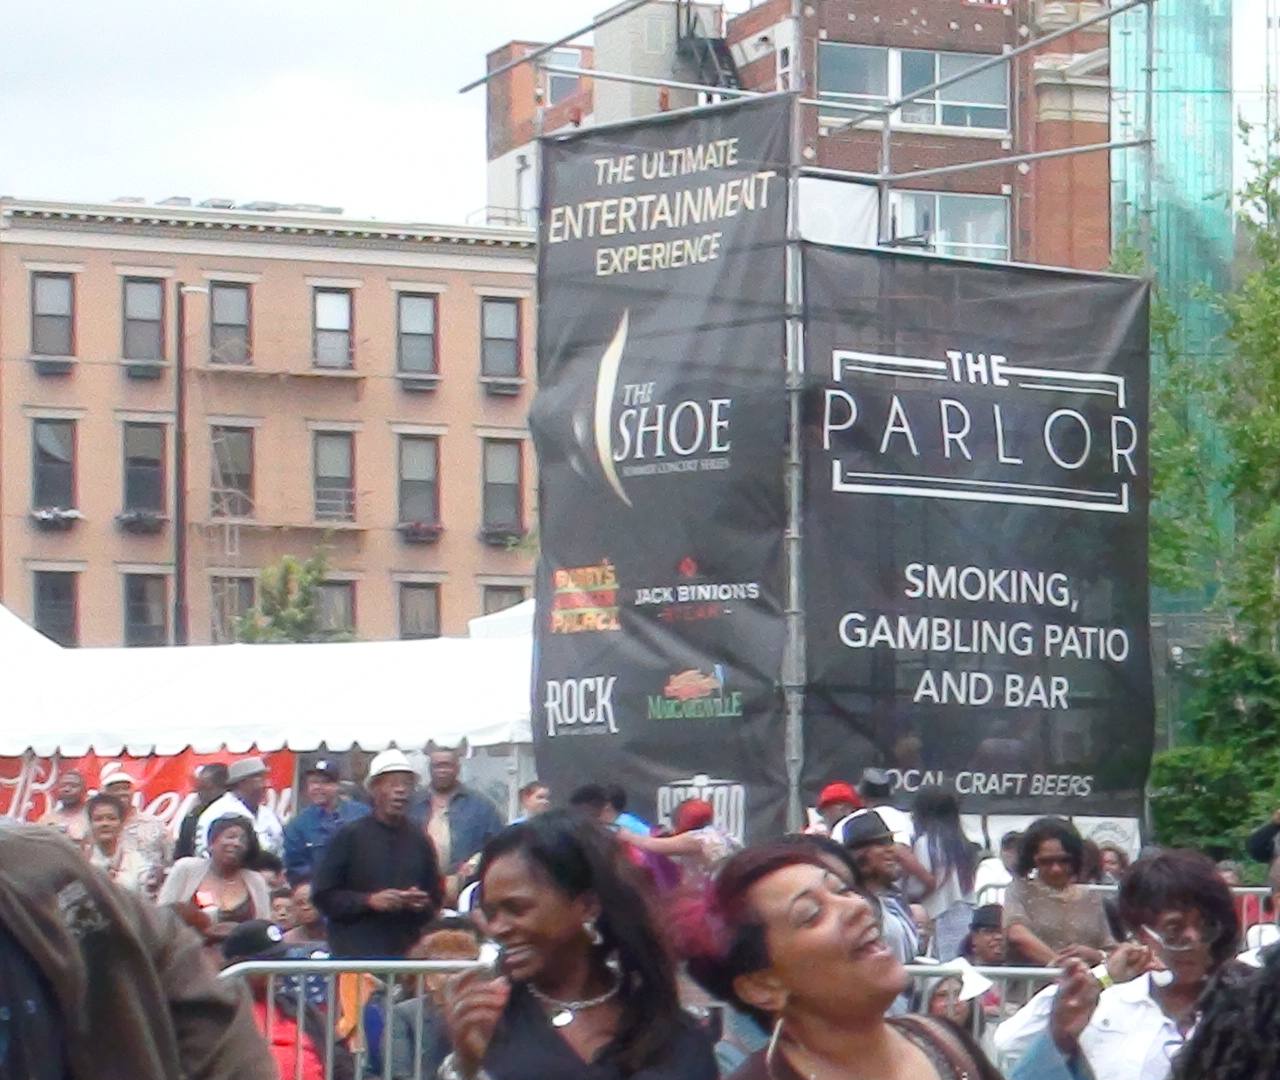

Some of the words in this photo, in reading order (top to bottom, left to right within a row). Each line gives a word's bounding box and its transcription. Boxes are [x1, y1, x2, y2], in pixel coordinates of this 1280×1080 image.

[595, 154, 636, 185] THE
[642, 138, 739, 180] ULTIMATE
[549, 171, 777, 243] ENTERTAINMENT
[596, 232, 722, 276] EXPERIENCE
[946, 350, 1010, 387] THE
[623, 382, 655, 405] THE
[613, 398, 732, 461] SHOE
[823, 389, 1138, 476] PARLOR
[635, 586, 675, 605] JACK
[904, 563, 1078, 612] SMOKING,
[839, 612, 1033, 656] GAMBLING
[1044, 625, 1129, 662] PATIO
[544, 676, 619, 736] ROCK
[913, 670, 993, 705] AND
[1005, 674, 1069, 709] BAR
[955, 772, 1029, 796] CRAFT
[1029, 774, 1094, 797] BEERS
